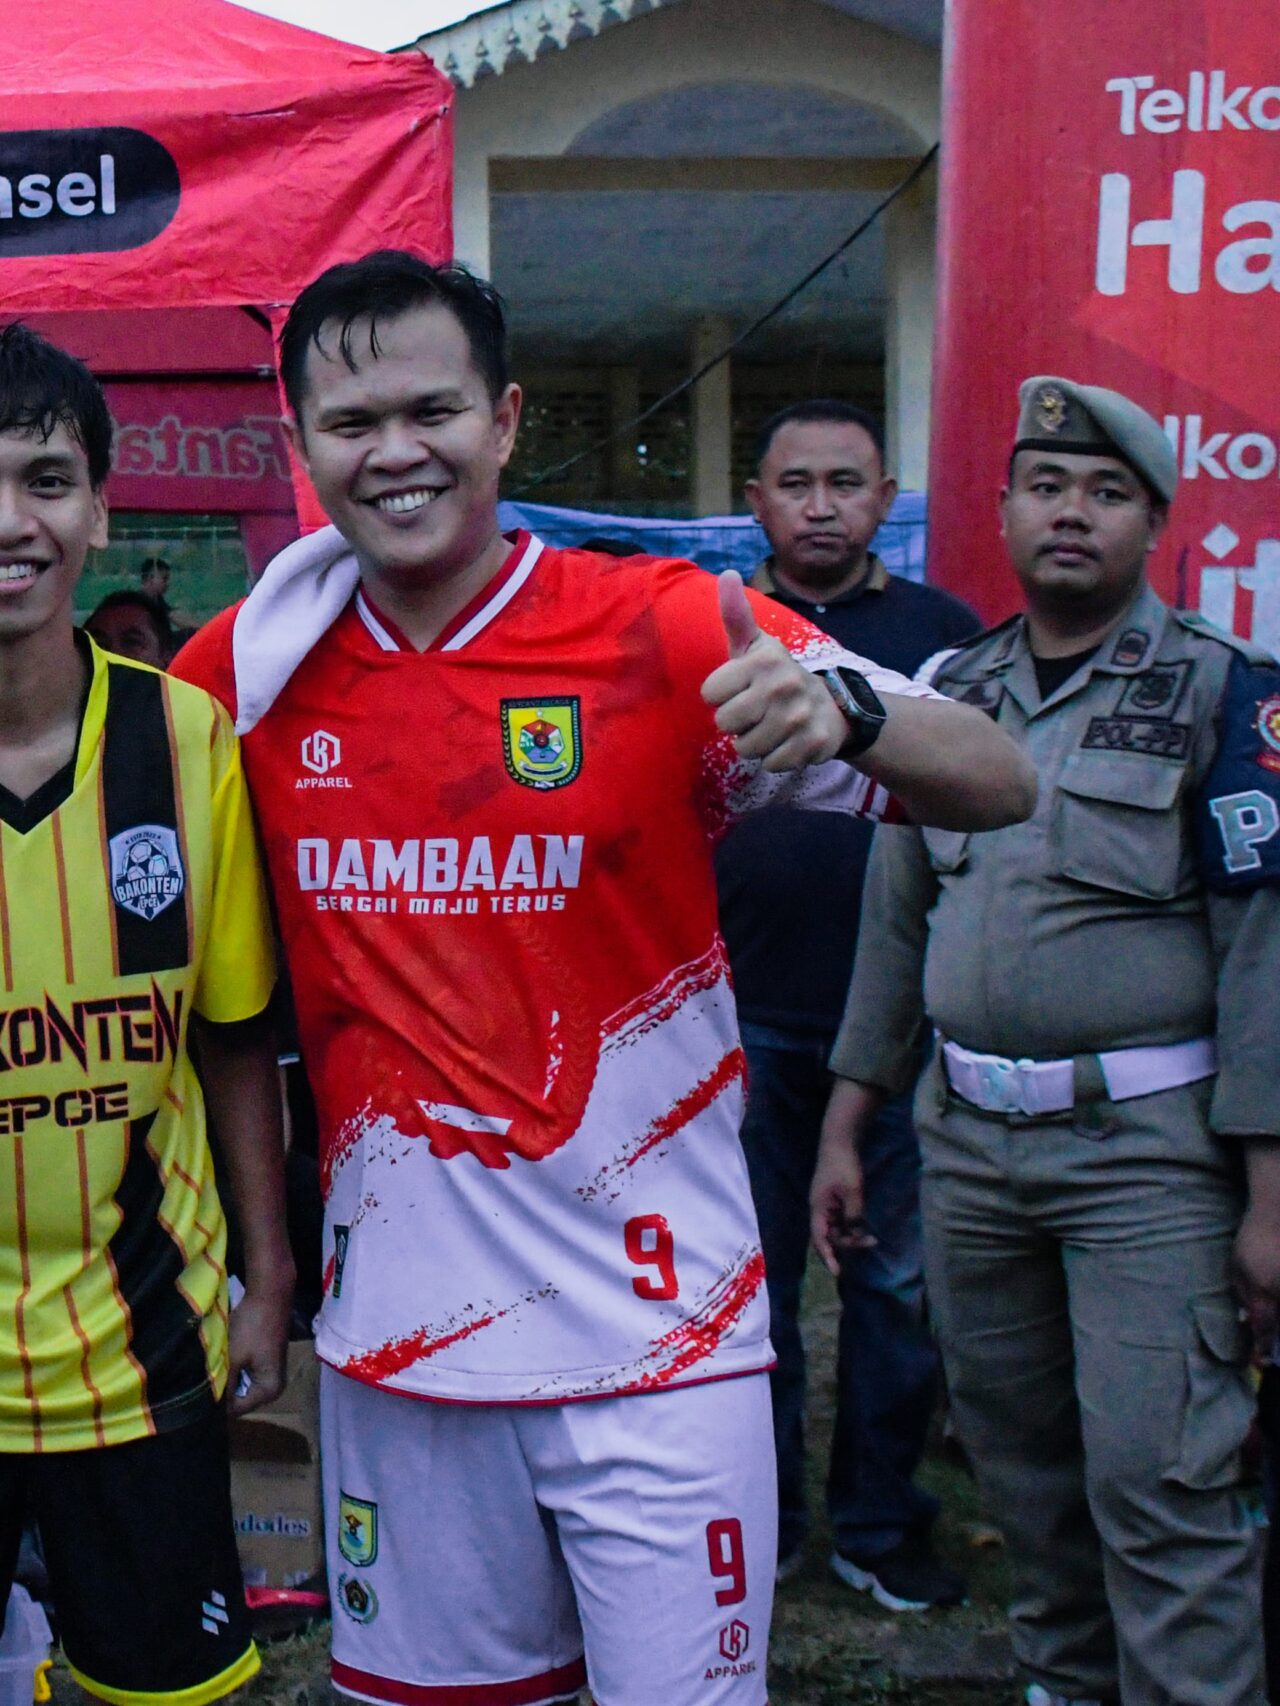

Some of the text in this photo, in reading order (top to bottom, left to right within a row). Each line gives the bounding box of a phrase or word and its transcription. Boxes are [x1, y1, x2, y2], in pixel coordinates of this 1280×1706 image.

[295, 776, 353, 789] APPAREL
[297, 834, 585, 893] DAMBAAN
[116, 878, 179, 902] BAKONTEN
[316, 894, 566, 914] SERGAI MAJU TERUS
[624, 1213, 679, 1301] 9
[706, 1517, 747, 1608] 9
[704, 1661, 756, 1681] APPAREL
